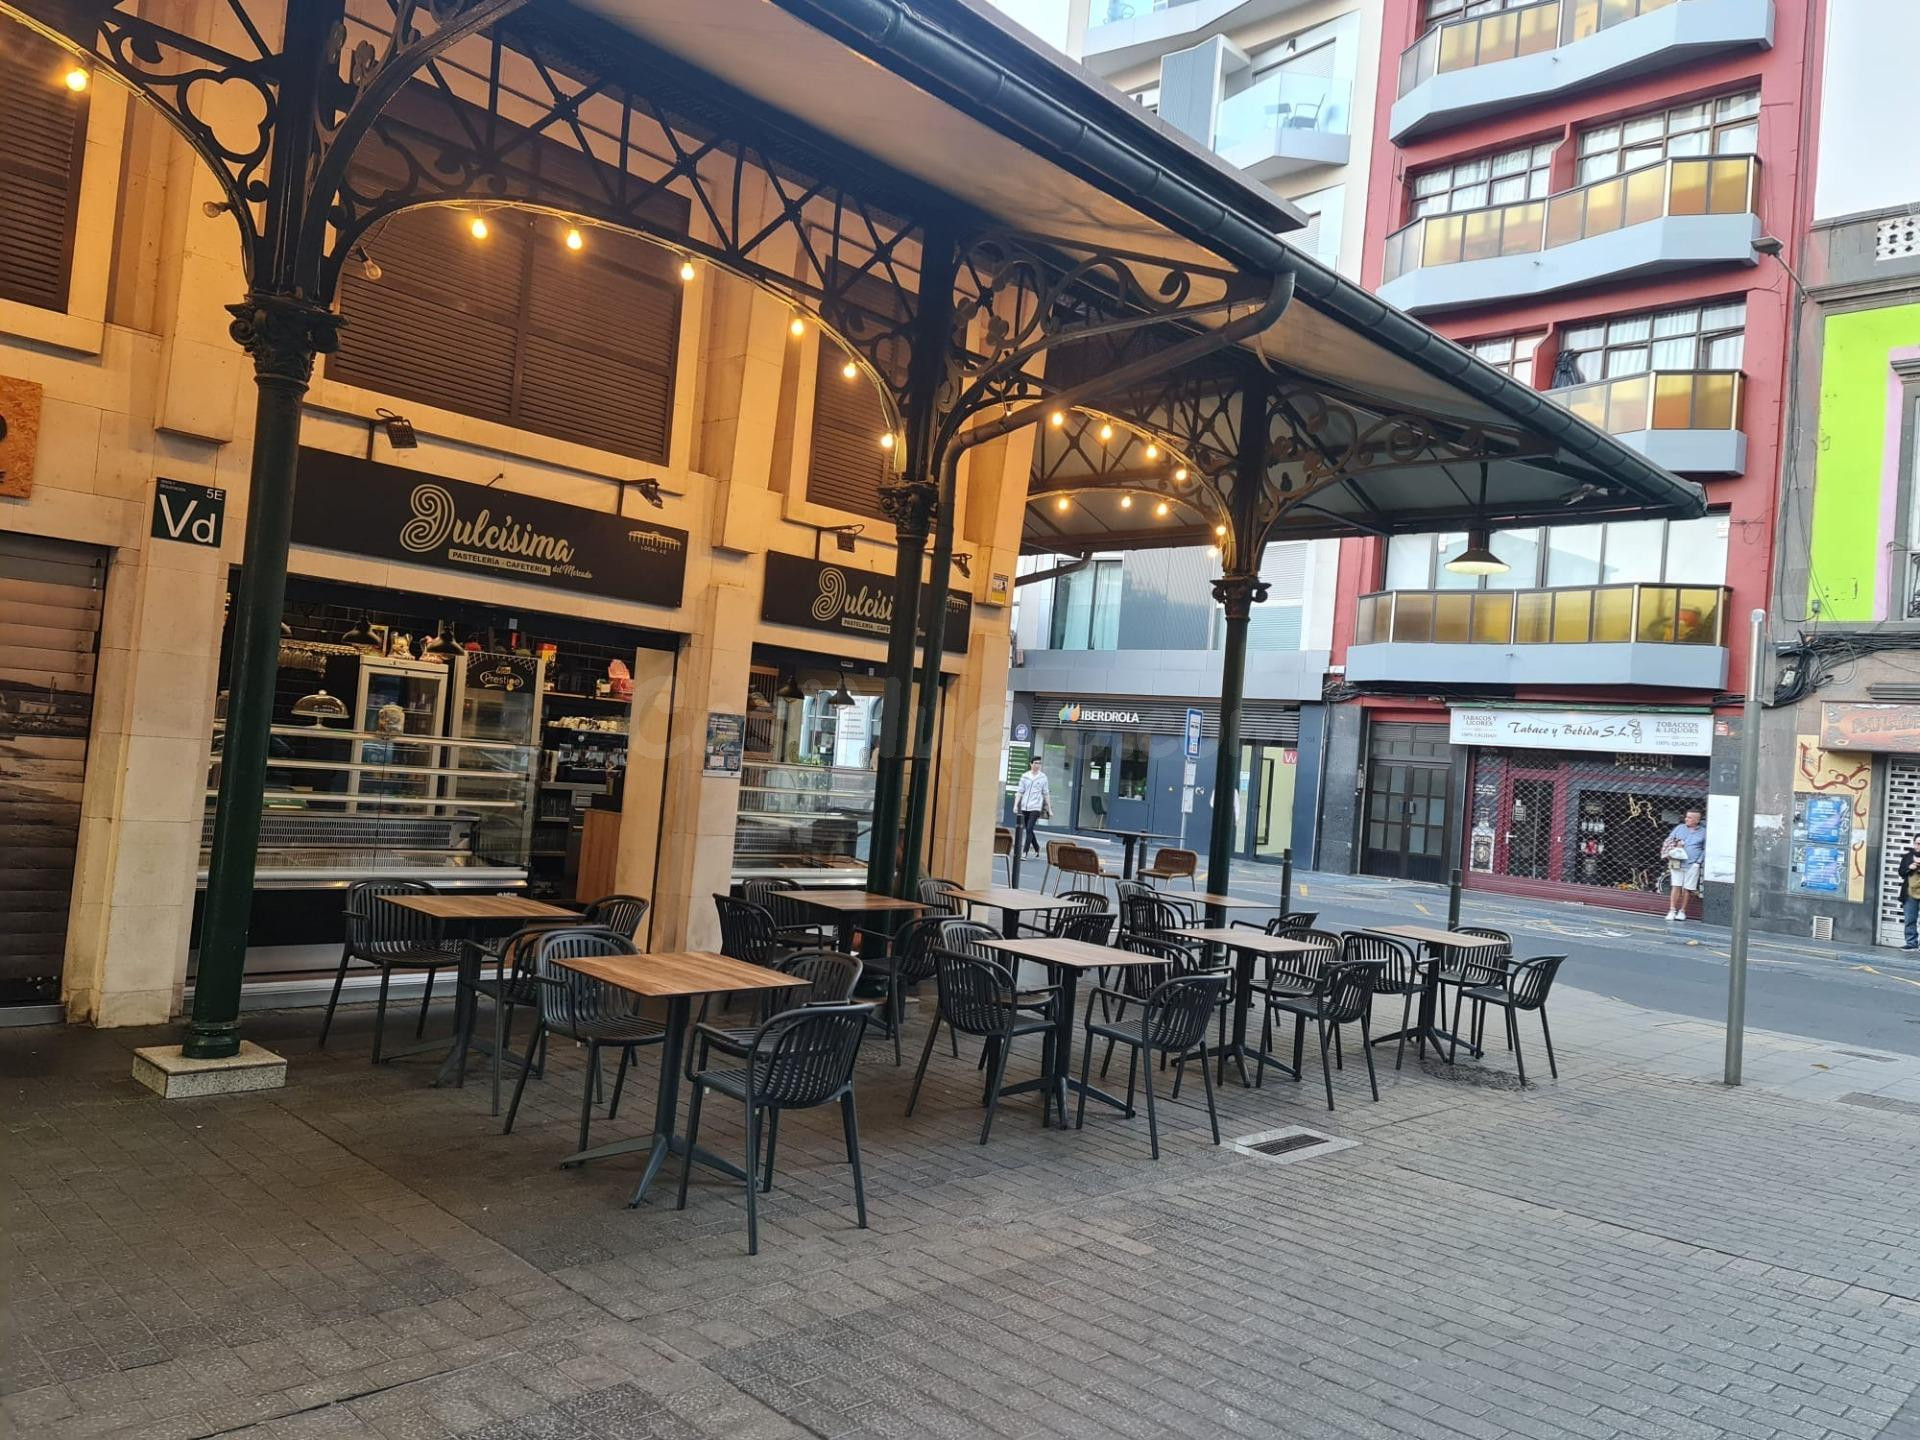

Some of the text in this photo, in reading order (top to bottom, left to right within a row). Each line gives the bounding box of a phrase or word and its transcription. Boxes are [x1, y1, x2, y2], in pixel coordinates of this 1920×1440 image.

[206, 488, 223, 500] 5E
[159, 494, 216, 543] Vd
[812, 567, 894, 621] Dulcísi
[1081, 710, 1140, 723] IBERDROLA
[1552, 728, 1558, 738] y
[1562, 724, 1599, 737] Bebida
